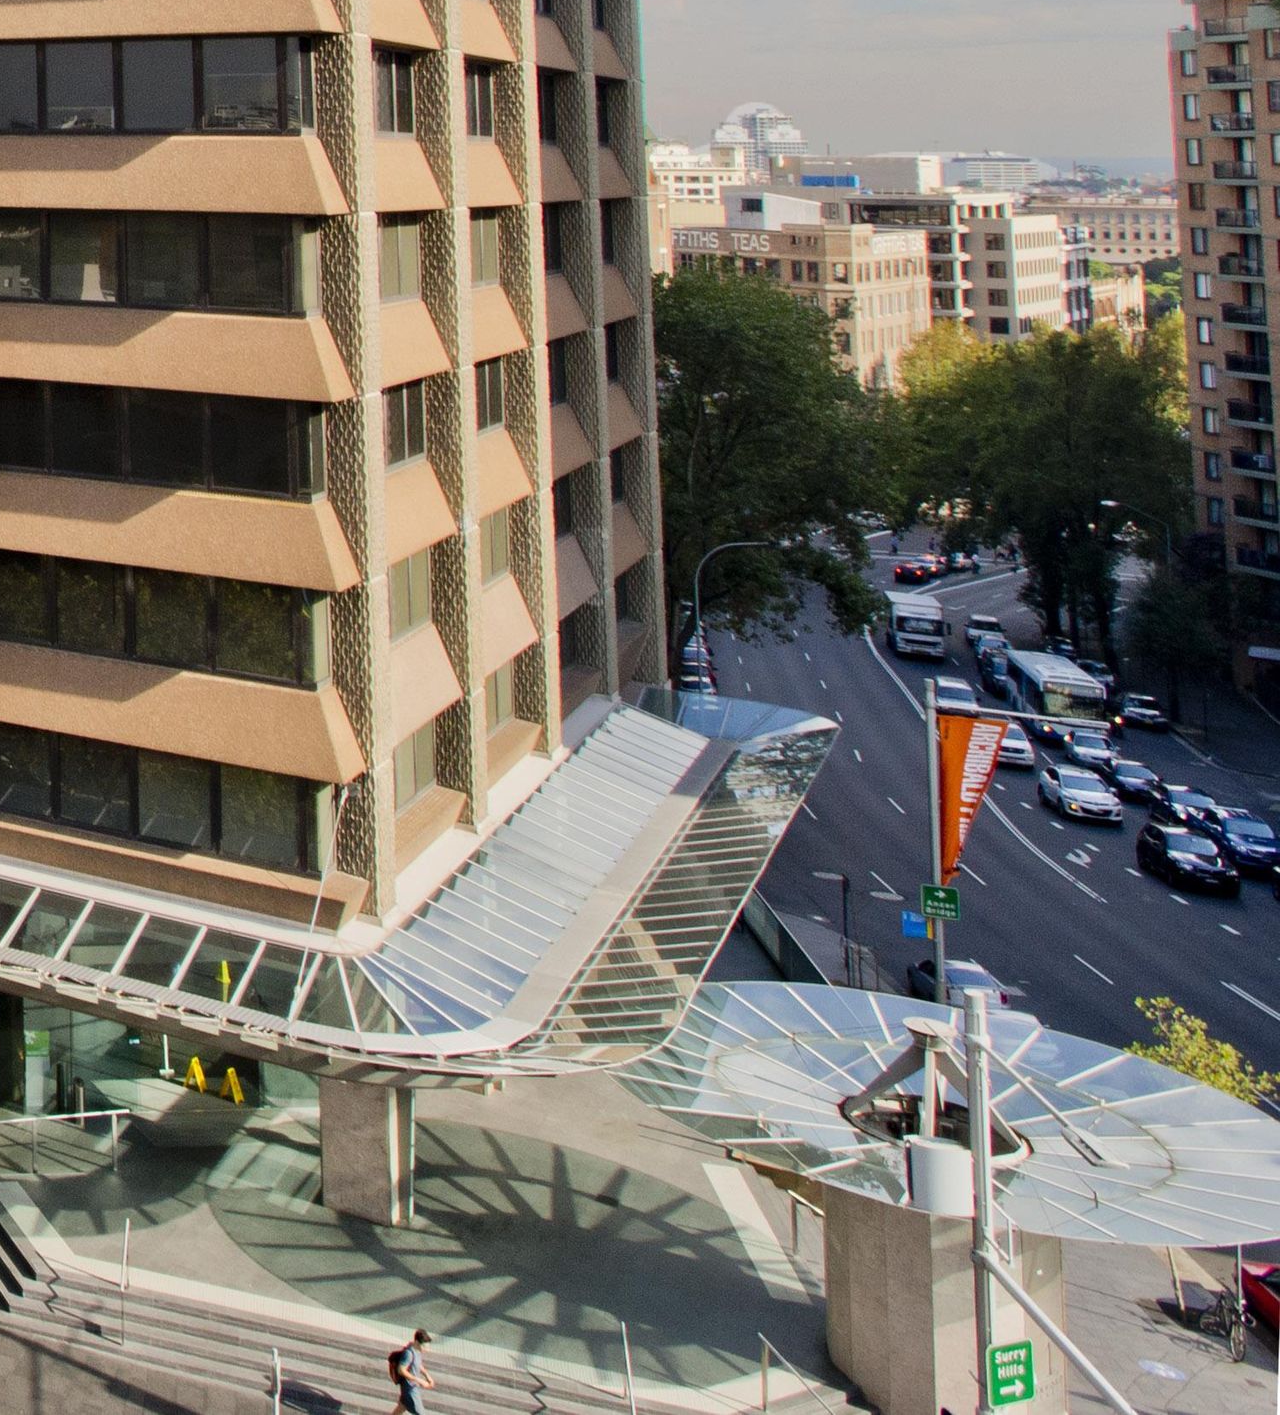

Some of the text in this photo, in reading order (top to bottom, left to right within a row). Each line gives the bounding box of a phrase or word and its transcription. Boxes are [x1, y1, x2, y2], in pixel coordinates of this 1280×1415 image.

[731, 232, 770, 252] TEAS
[925, 906, 957, 917] Bridge
[926, 899, 955, 909] Anzac
[995, 1348, 1026, 1364] Surry
[998, 1364, 1025, 1379] Hills
